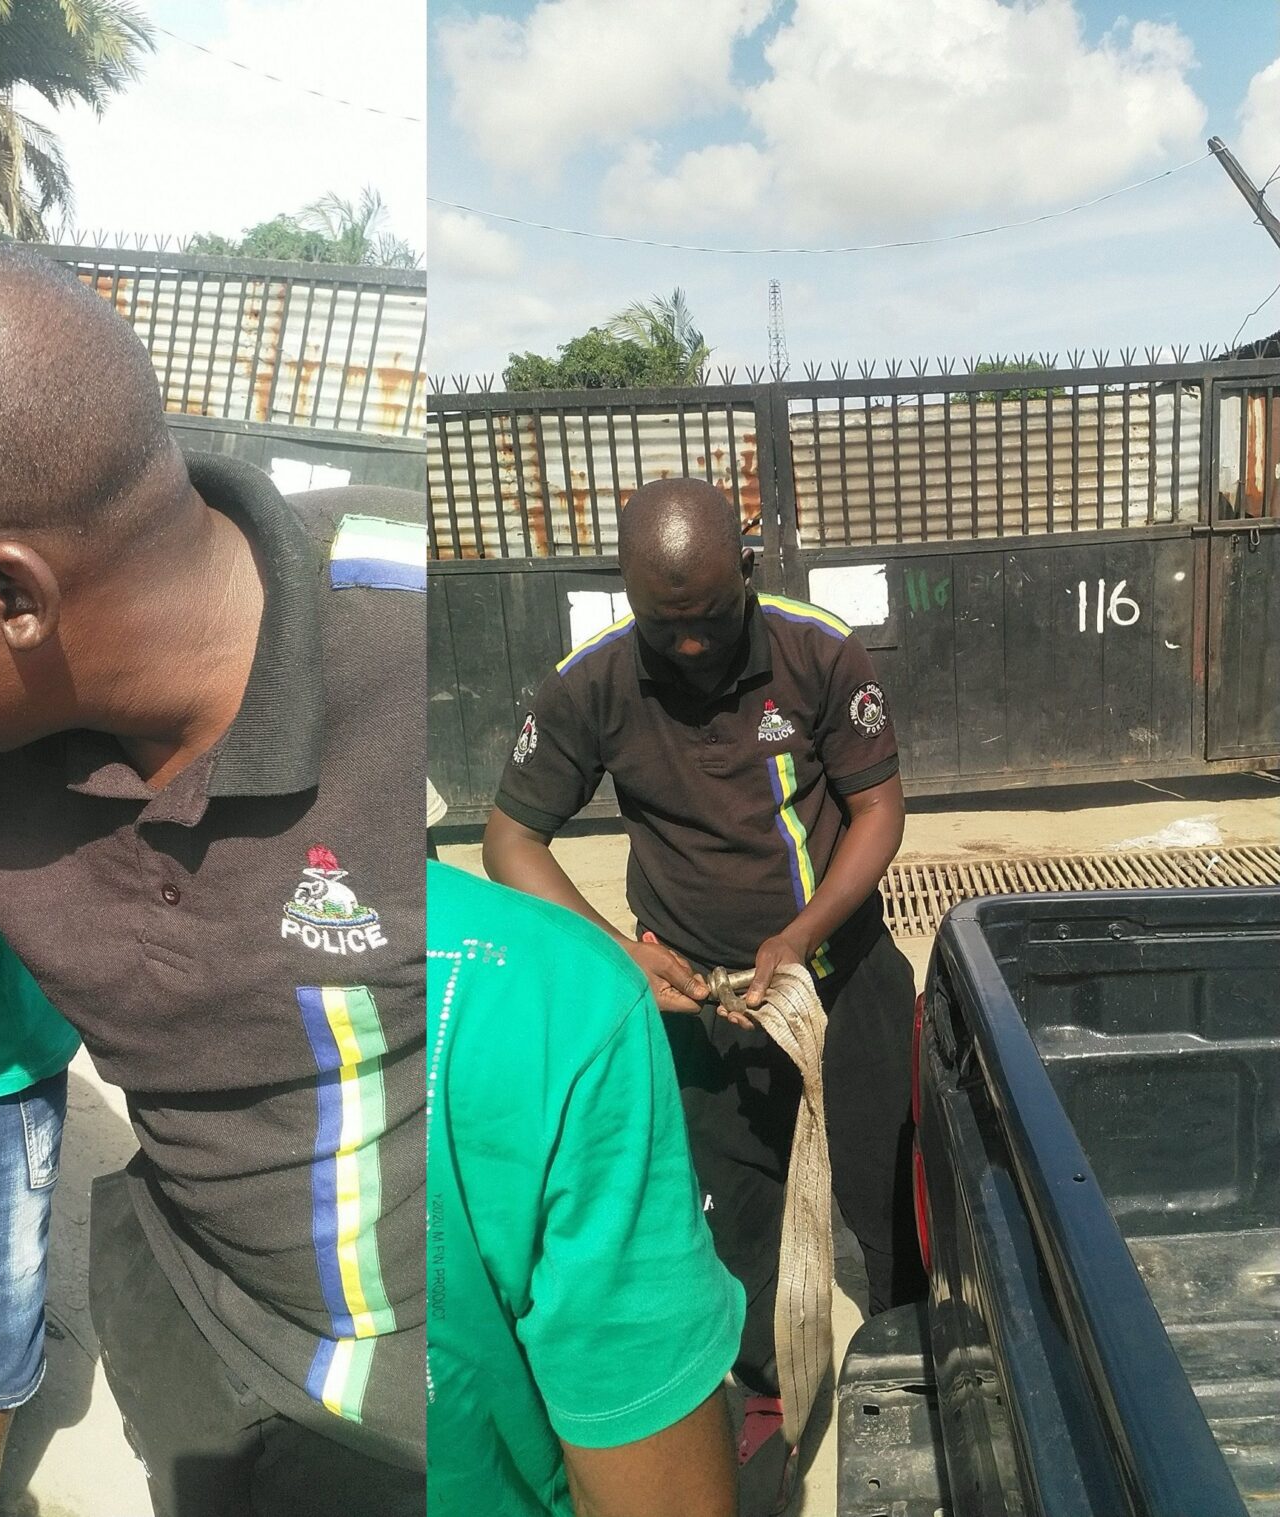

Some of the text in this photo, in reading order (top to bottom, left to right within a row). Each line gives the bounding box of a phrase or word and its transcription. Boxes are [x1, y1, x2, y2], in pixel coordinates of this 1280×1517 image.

[1078, 578, 1141, 634] 116
[757, 725, 796, 742] POLICE
[281, 918, 389, 956] POLICE
[432, 1269, 446, 1321] PRODUCT
